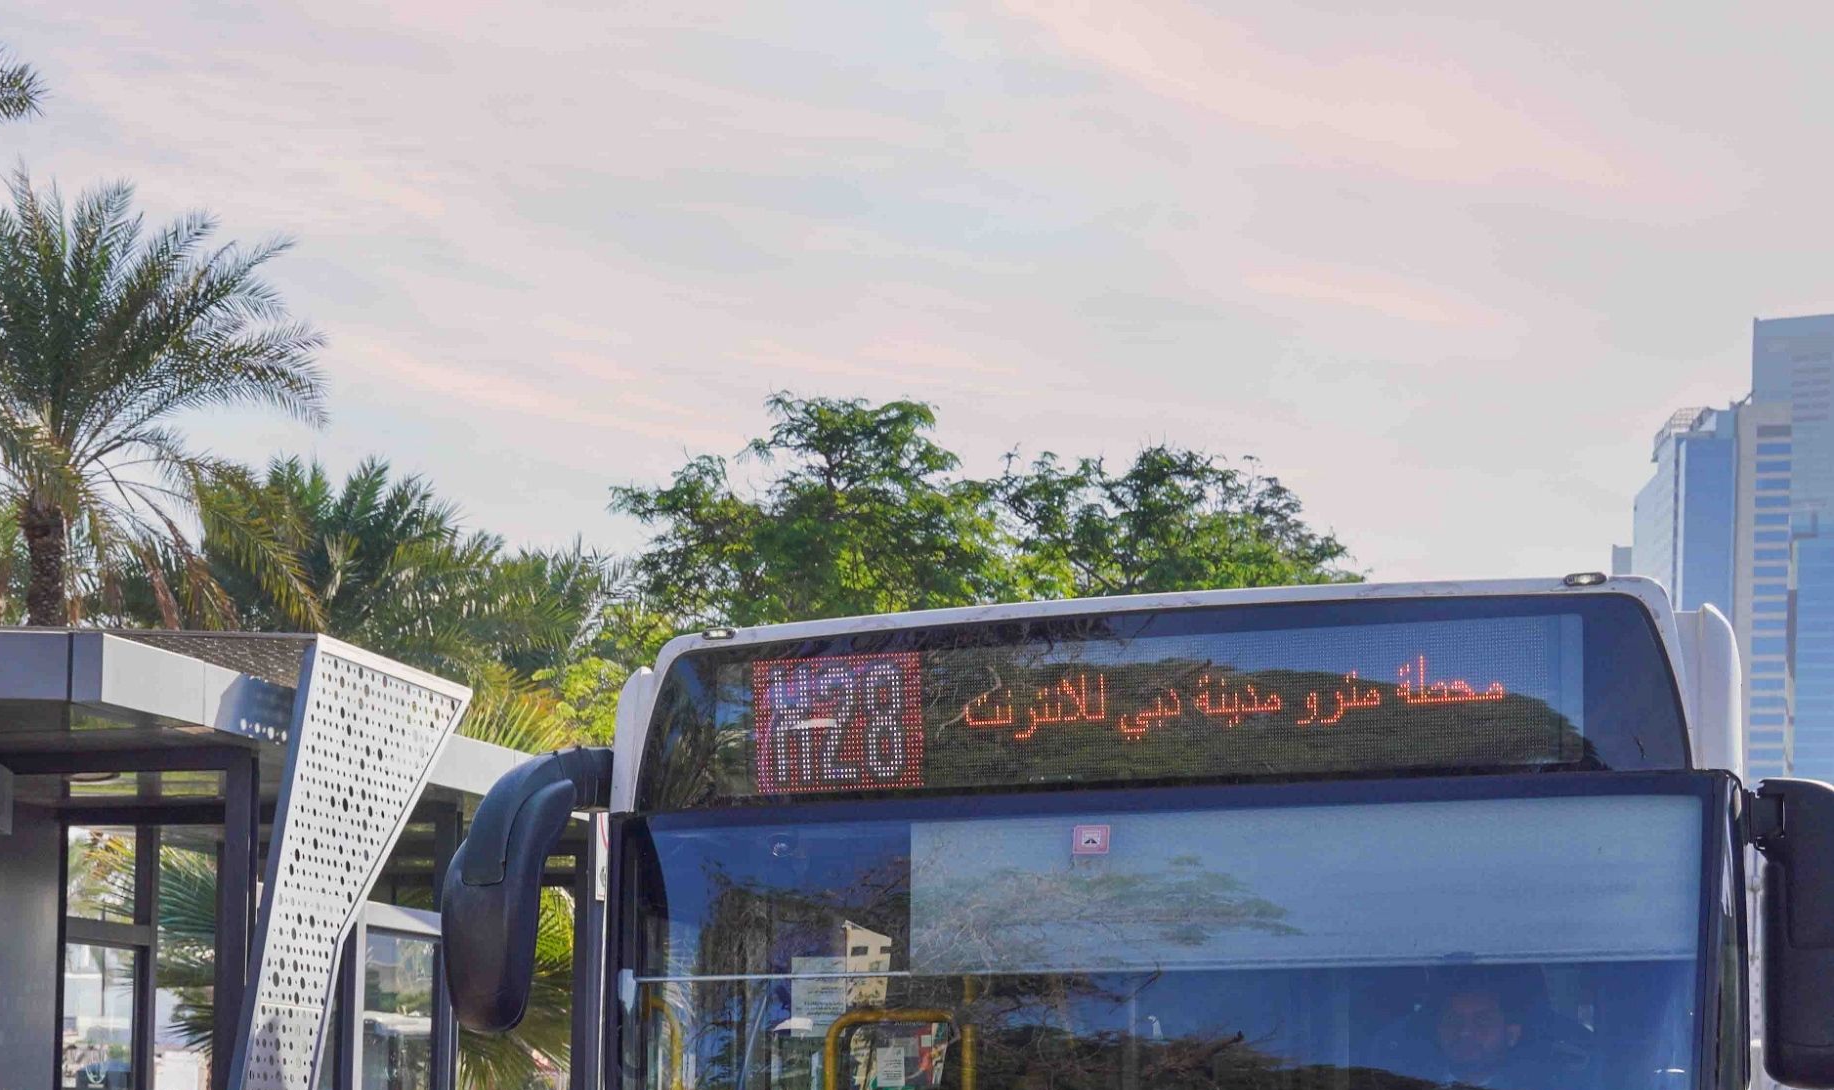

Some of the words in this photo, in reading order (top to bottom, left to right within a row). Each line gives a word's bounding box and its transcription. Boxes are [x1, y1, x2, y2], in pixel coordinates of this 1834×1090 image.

[1192, 664, 1282, 728] مدينة
[1296, 669, 1381, 726] مترو
[1396, 654, 1504, 704] محطة
[1120, 687, 1181, 741] دبي
